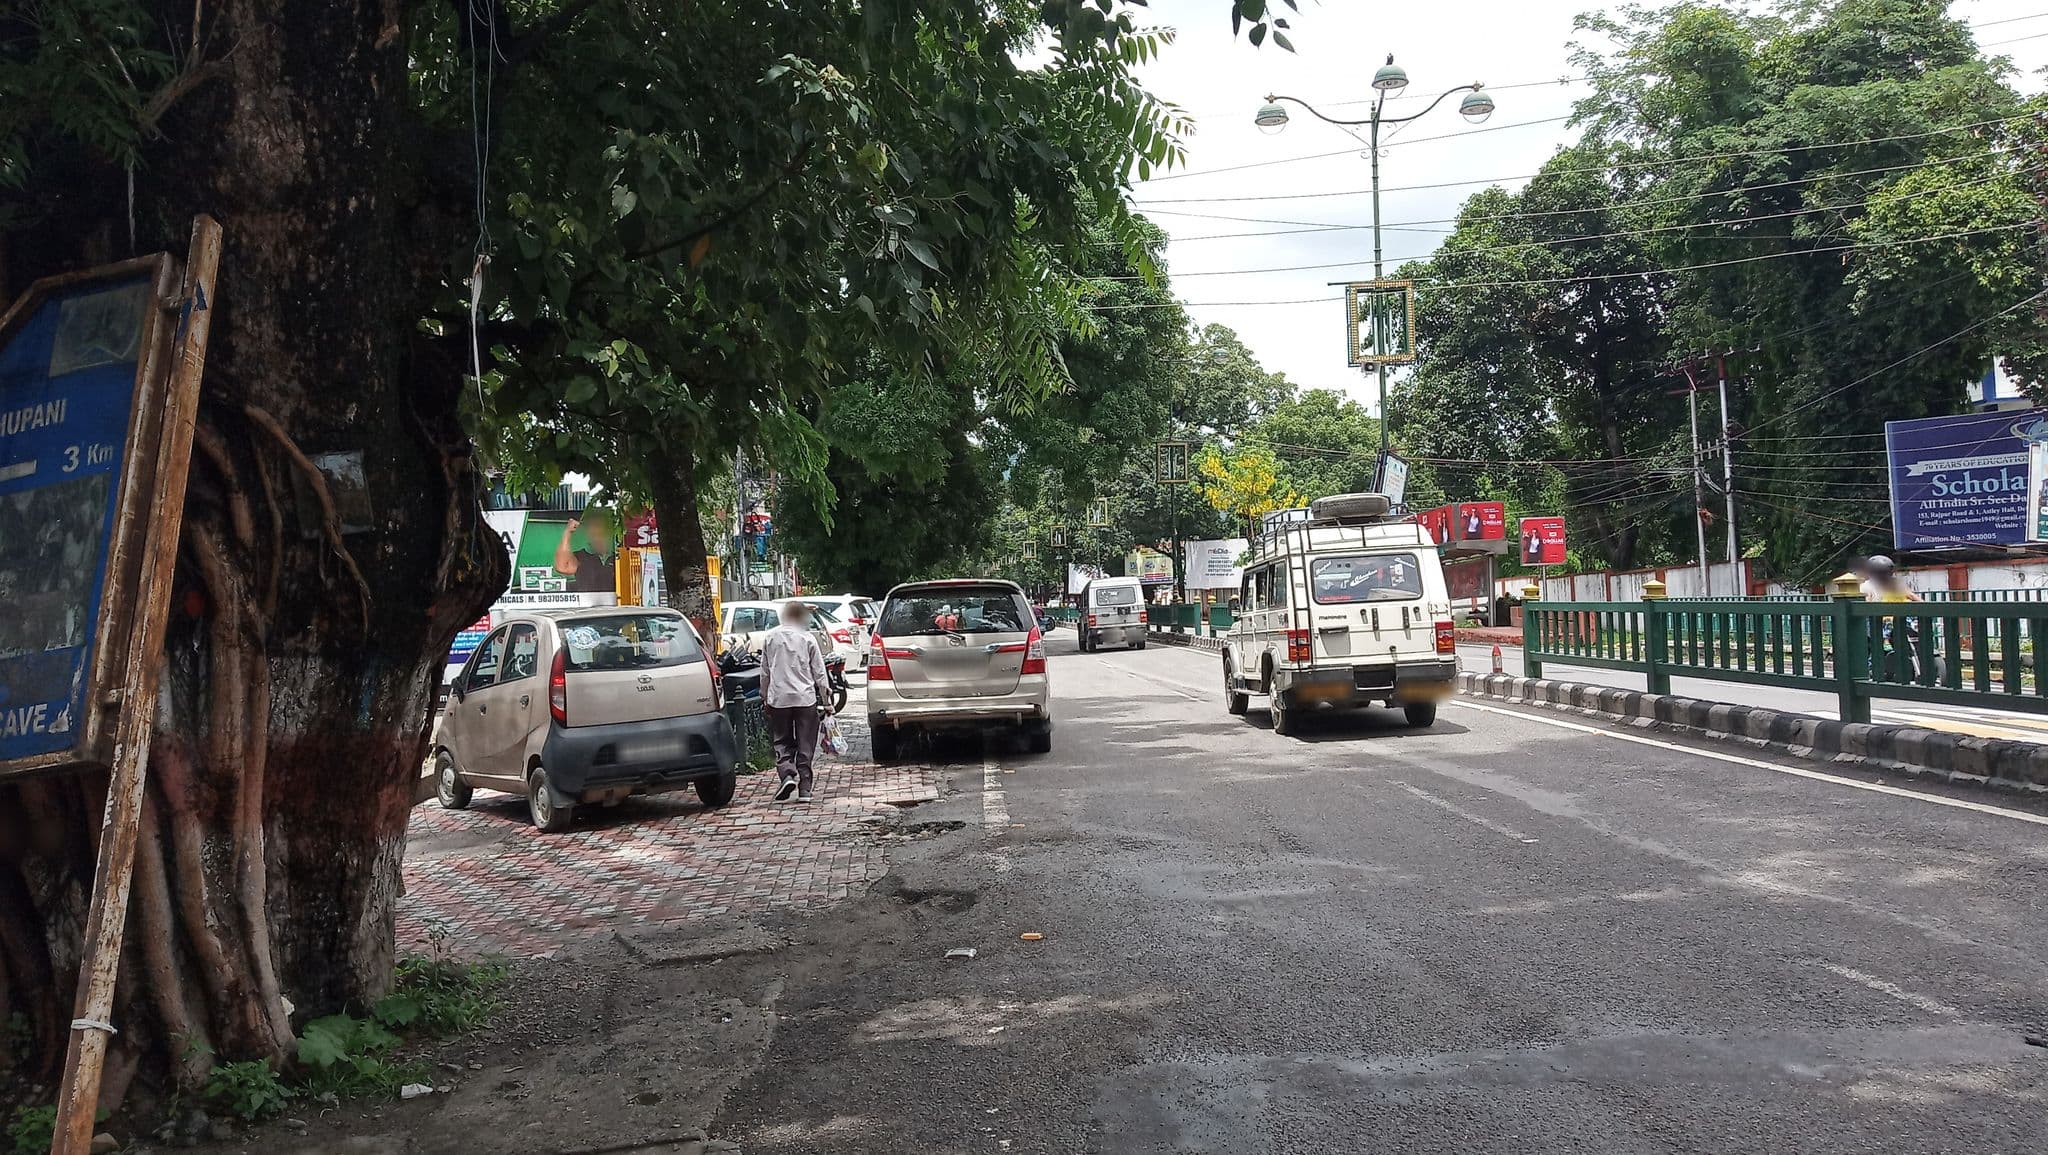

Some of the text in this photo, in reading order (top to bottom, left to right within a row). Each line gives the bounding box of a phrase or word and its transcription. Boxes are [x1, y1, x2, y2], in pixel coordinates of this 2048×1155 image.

[62, 446, 80, 472] 3
[1934, 460, 1962, 469] YEARS
[1963, 459, 1976, 467] OF
[1932, 467, 2027, 497] Schola
[1919, 500, 1937, 509] All
[1939, 498, 1968, 508] India
[1970, 496, 1985, 506] Sr.
[1914, 535, 1949, 544] Affiliation
